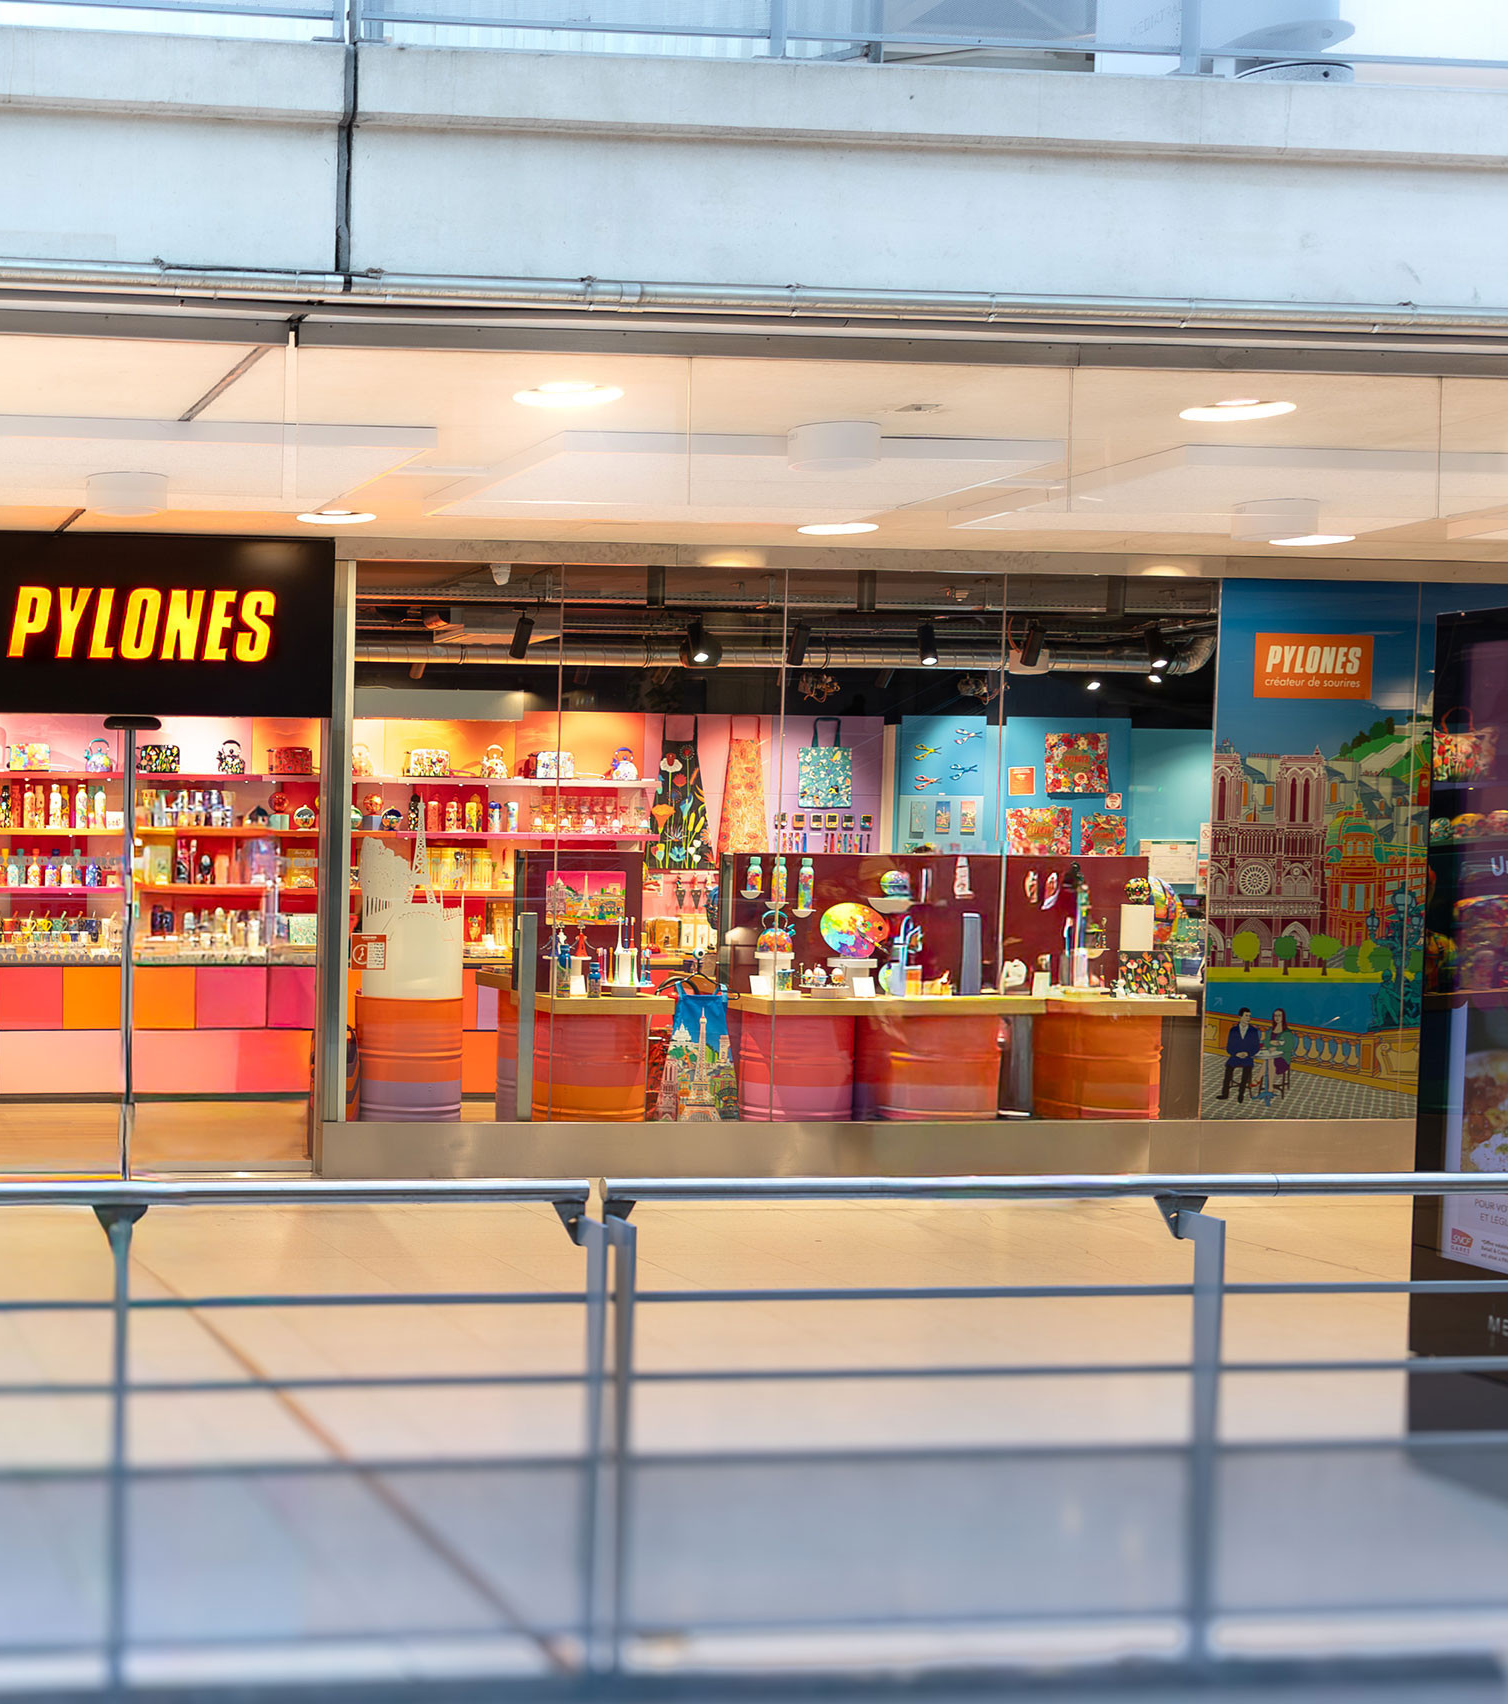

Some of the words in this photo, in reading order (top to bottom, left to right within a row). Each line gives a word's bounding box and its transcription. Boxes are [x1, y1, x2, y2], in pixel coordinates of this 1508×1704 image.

[6, 585, 276, 662] PYLONES
[1266, 646, 1362, 674] PYLONES
[1264, 676, 1305, 687] créateur
[1308, 675, 1321, 687] de
[1323, 678, 1361, 688] sourires
[1491, 855, 1508, 876] U
